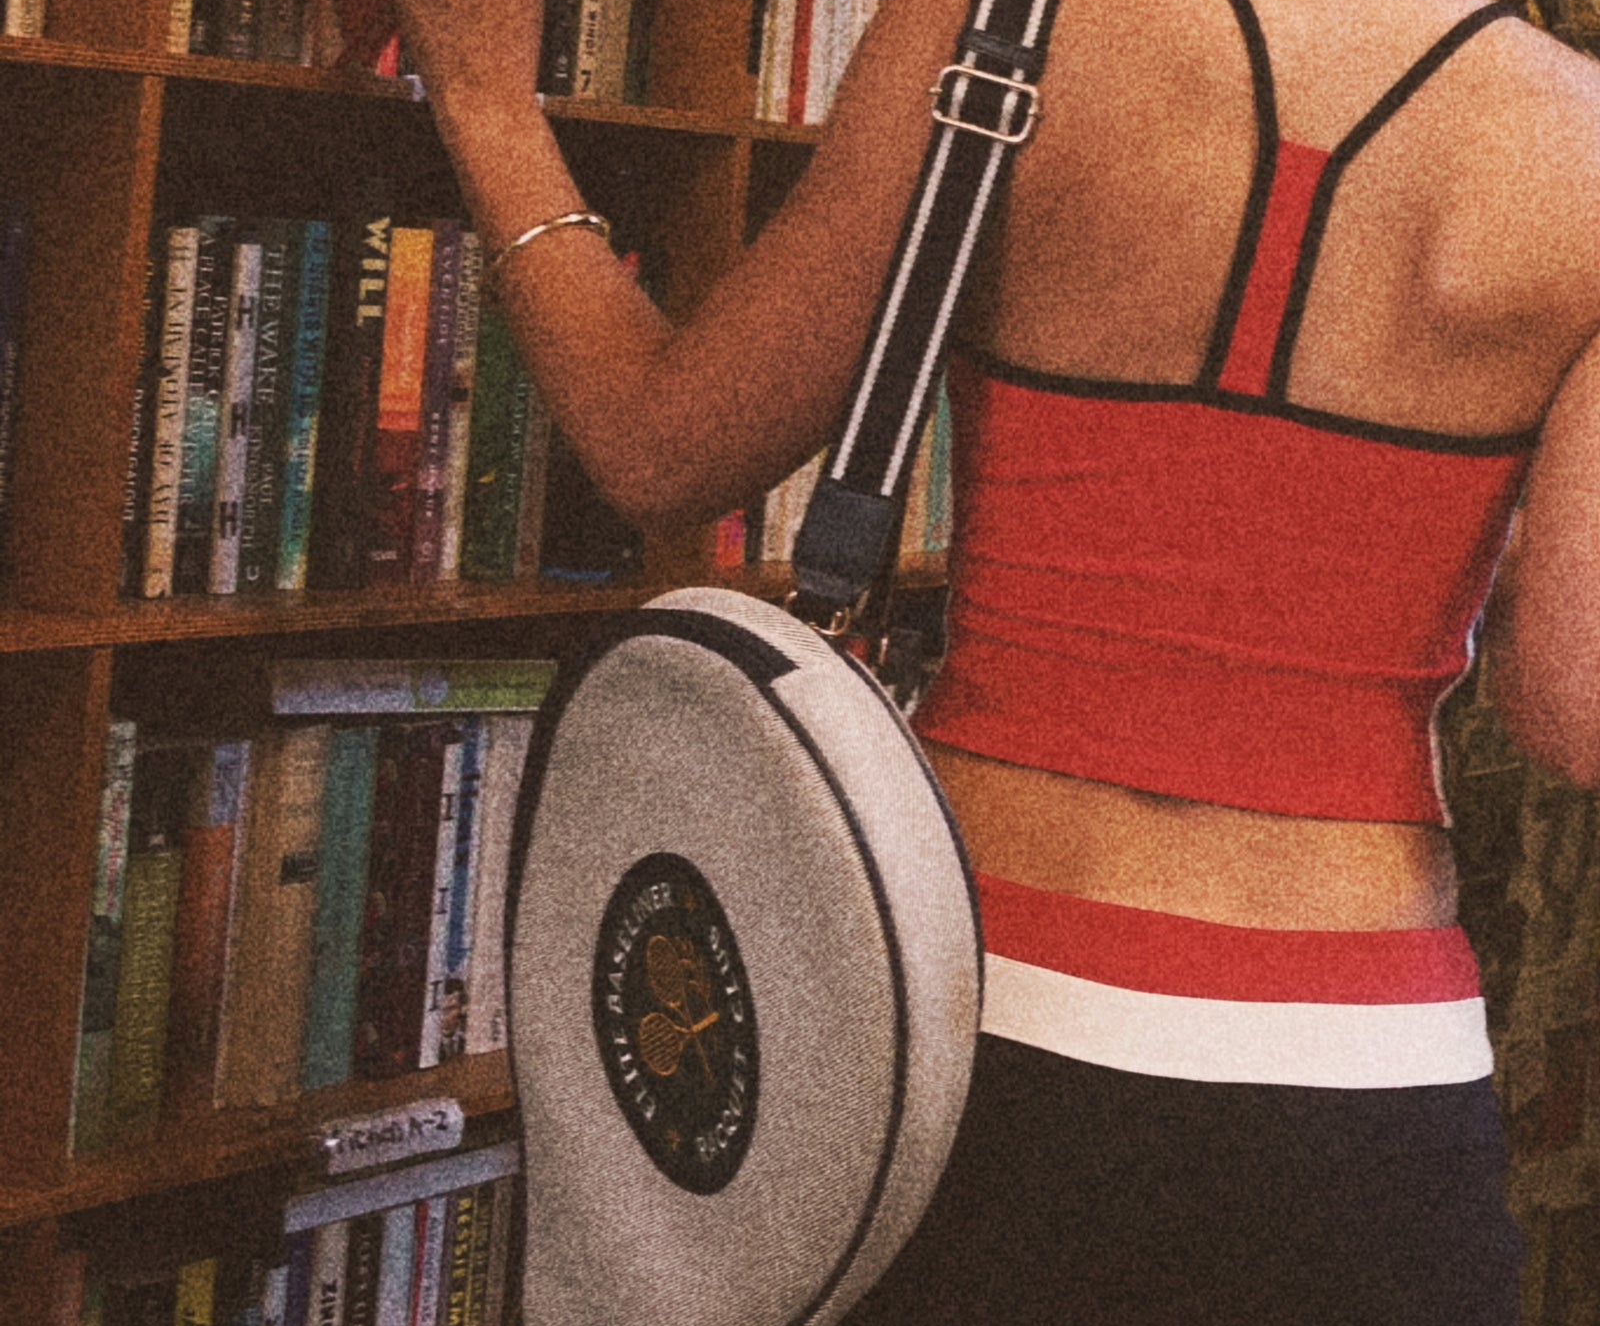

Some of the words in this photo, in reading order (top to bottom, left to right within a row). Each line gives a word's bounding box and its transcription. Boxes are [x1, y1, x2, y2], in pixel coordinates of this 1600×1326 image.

[195, 252, 214, 318] PLACE
[263, 243, 286, 313] THE
[355, 216, 391, 328] WILL
[255, 321, 280, 405] WAKE
[448, 1197, 474, 1281] BESSIE
